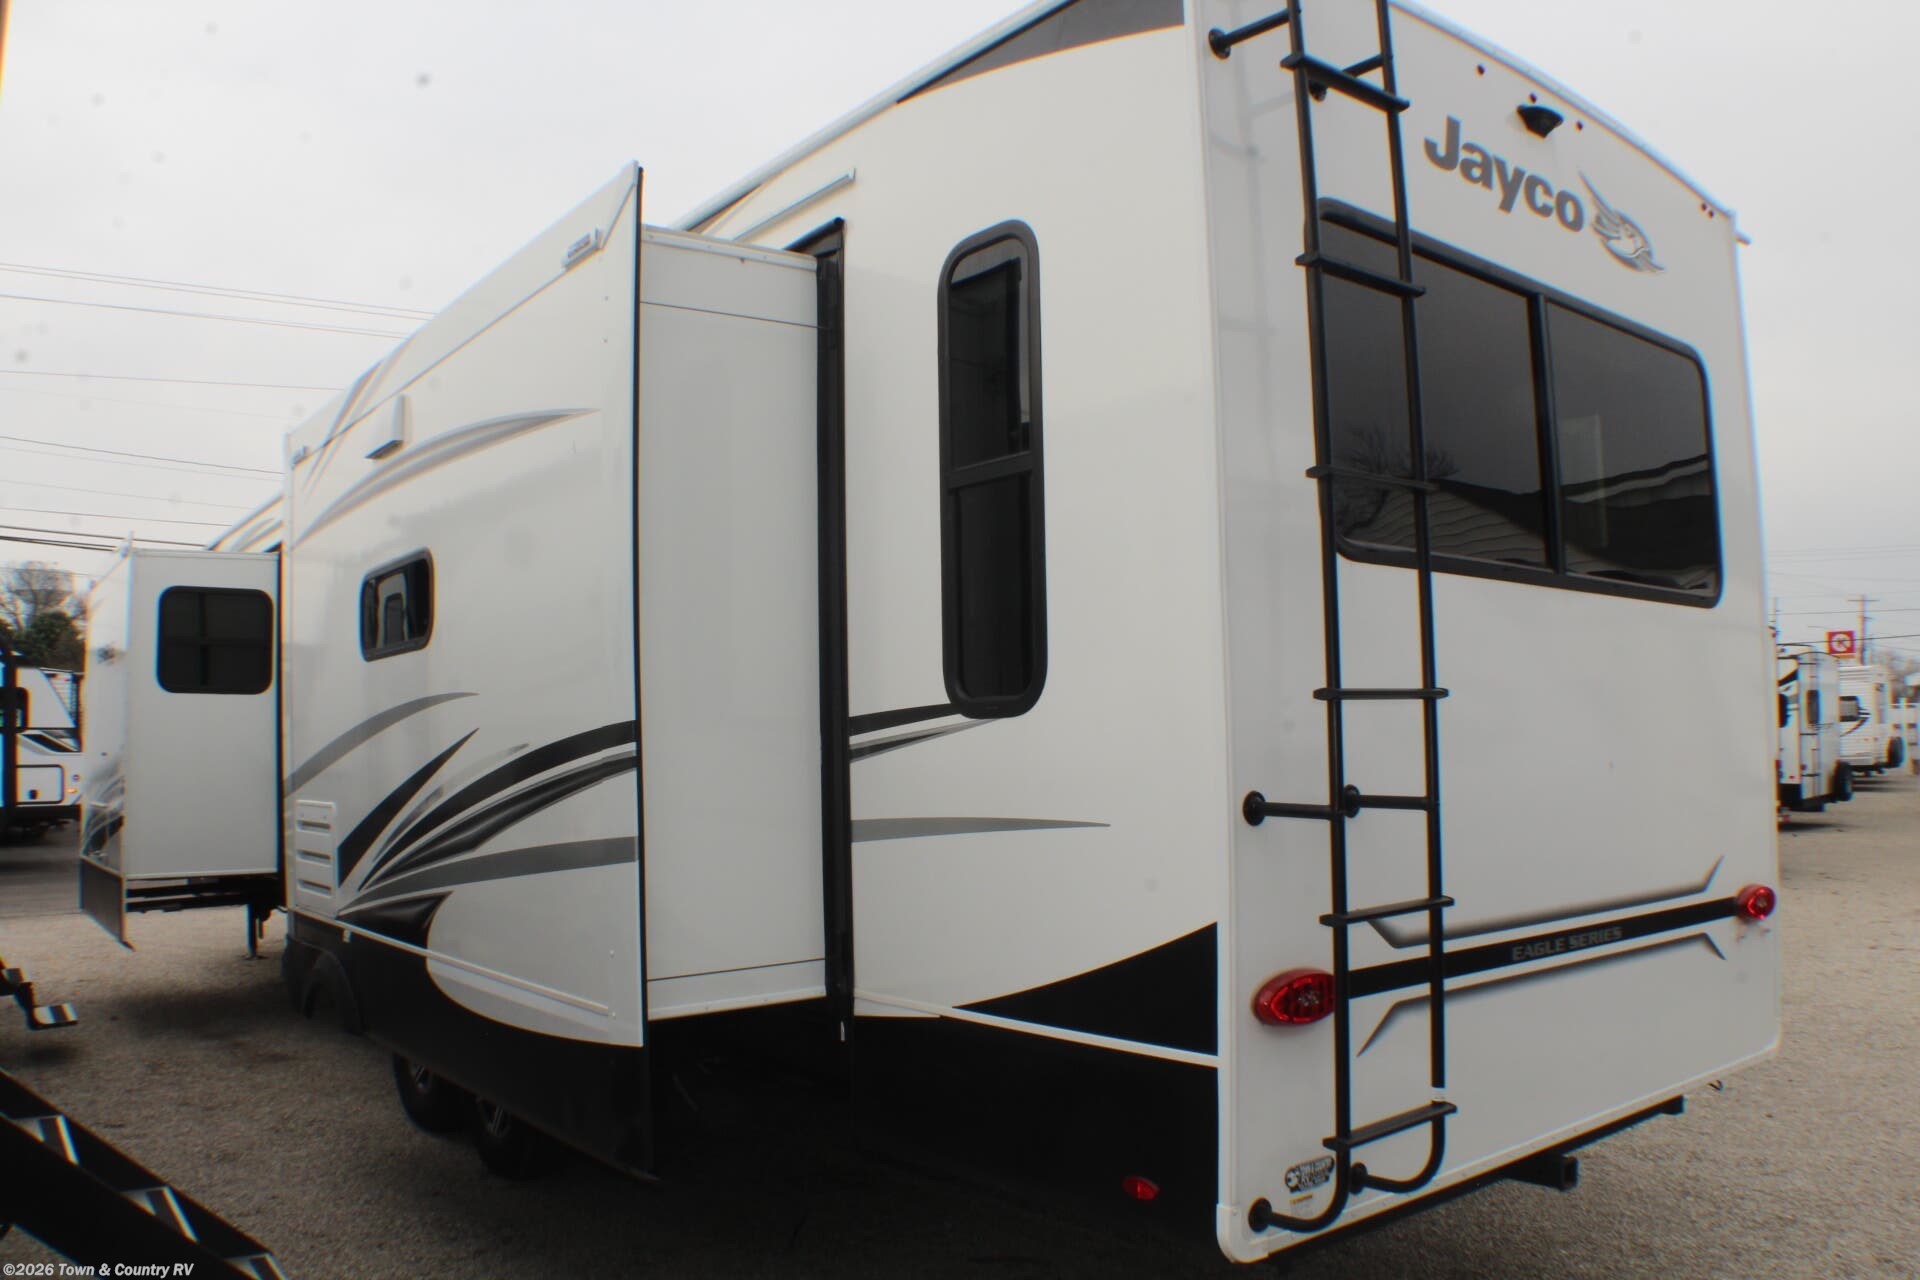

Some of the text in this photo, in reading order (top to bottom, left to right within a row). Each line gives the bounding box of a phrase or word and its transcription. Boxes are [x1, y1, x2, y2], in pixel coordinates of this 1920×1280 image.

[1424, 115, 1585, 232] Jayco
[1511, 925, 1624, 961] EAGLE SERIES
